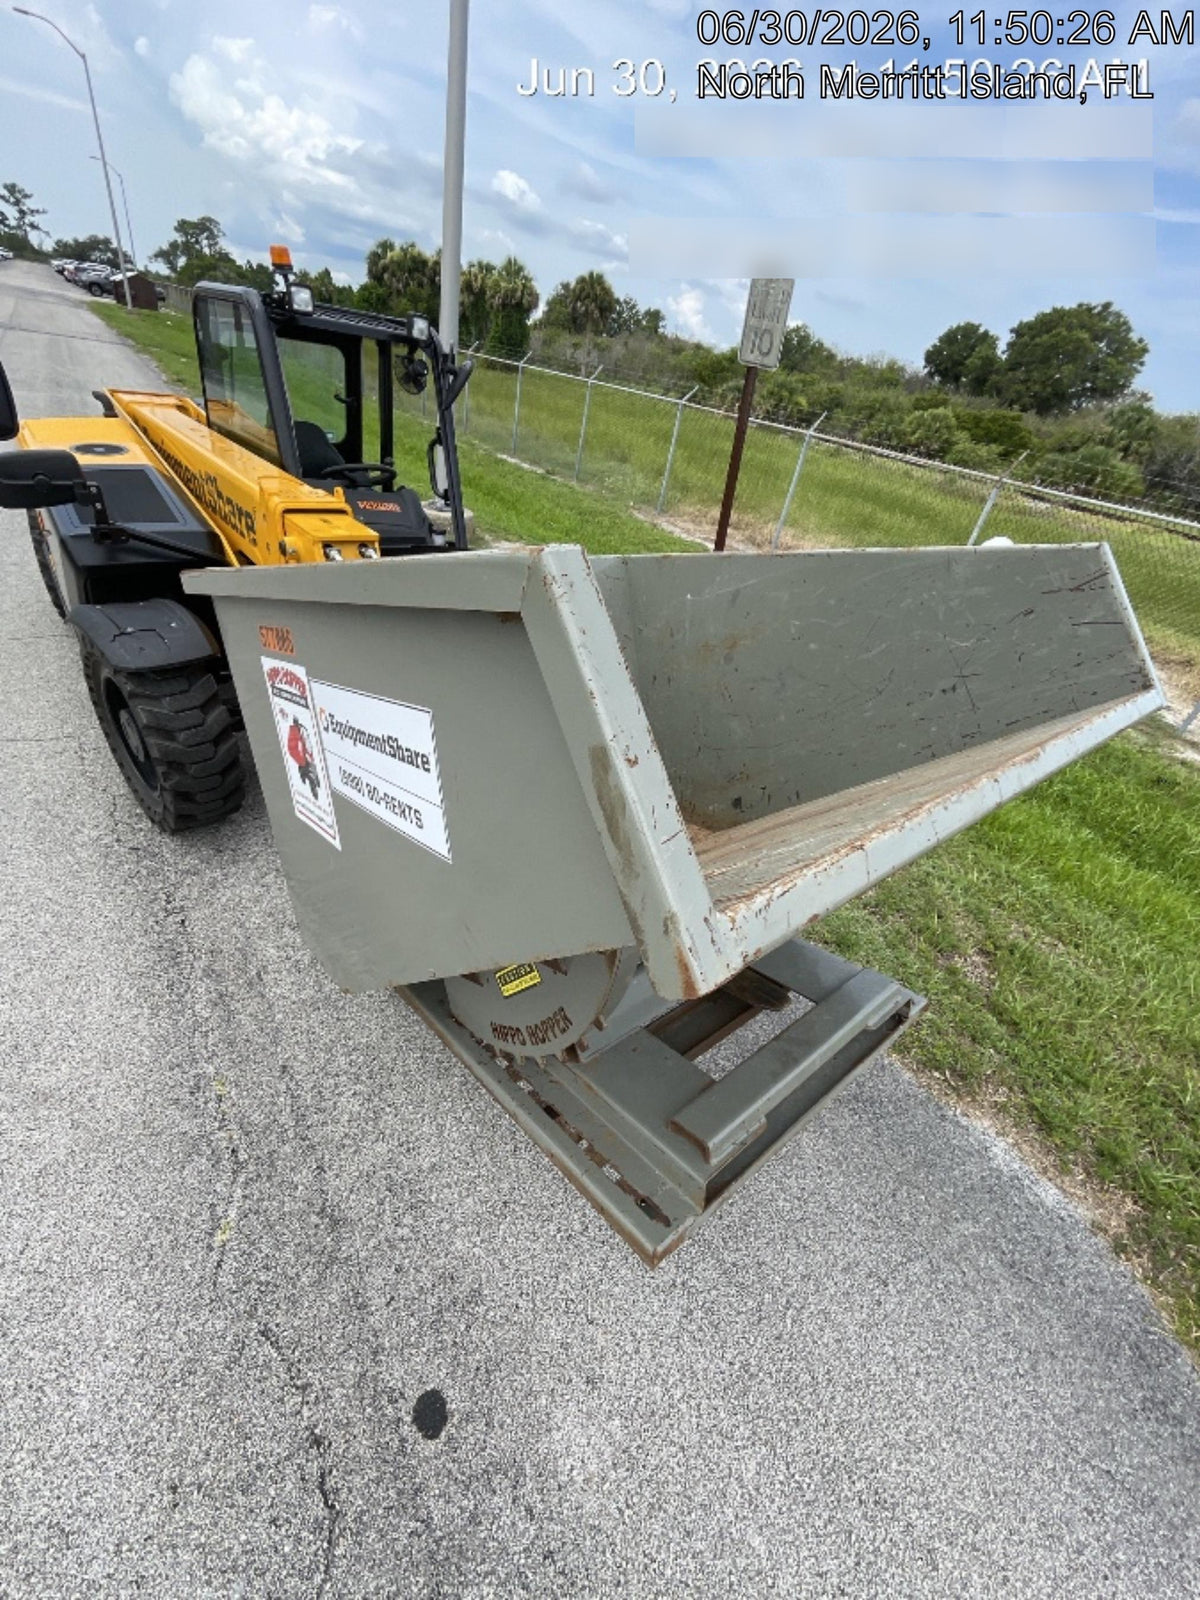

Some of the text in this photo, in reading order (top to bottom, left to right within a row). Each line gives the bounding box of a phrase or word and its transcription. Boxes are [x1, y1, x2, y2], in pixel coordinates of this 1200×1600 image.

[328, 712, 431, 774] EquipmentShare
[490, 1006, 573, 1047] HIPPO HOPPER
